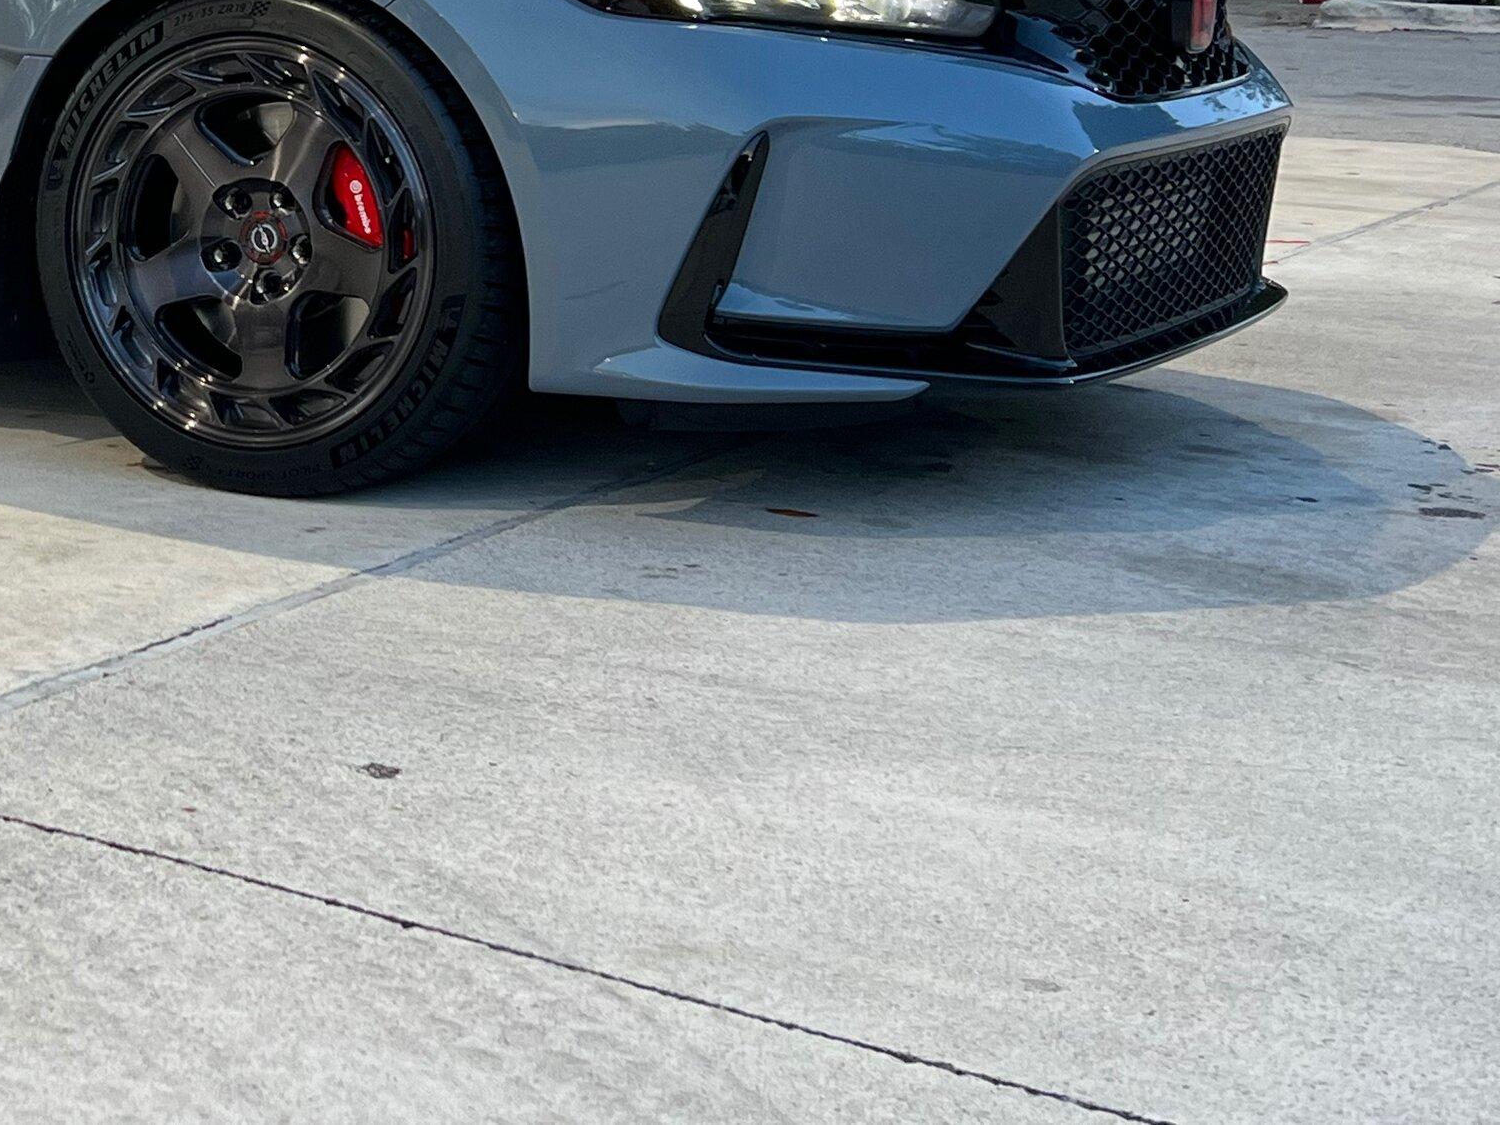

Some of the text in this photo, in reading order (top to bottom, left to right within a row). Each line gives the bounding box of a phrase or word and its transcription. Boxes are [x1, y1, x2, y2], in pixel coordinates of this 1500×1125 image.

[59, 23, 158, 152] MICHELIN
[353, 193, 373, 235] brembo
[337, 336, 450, 465] MICHELIN
